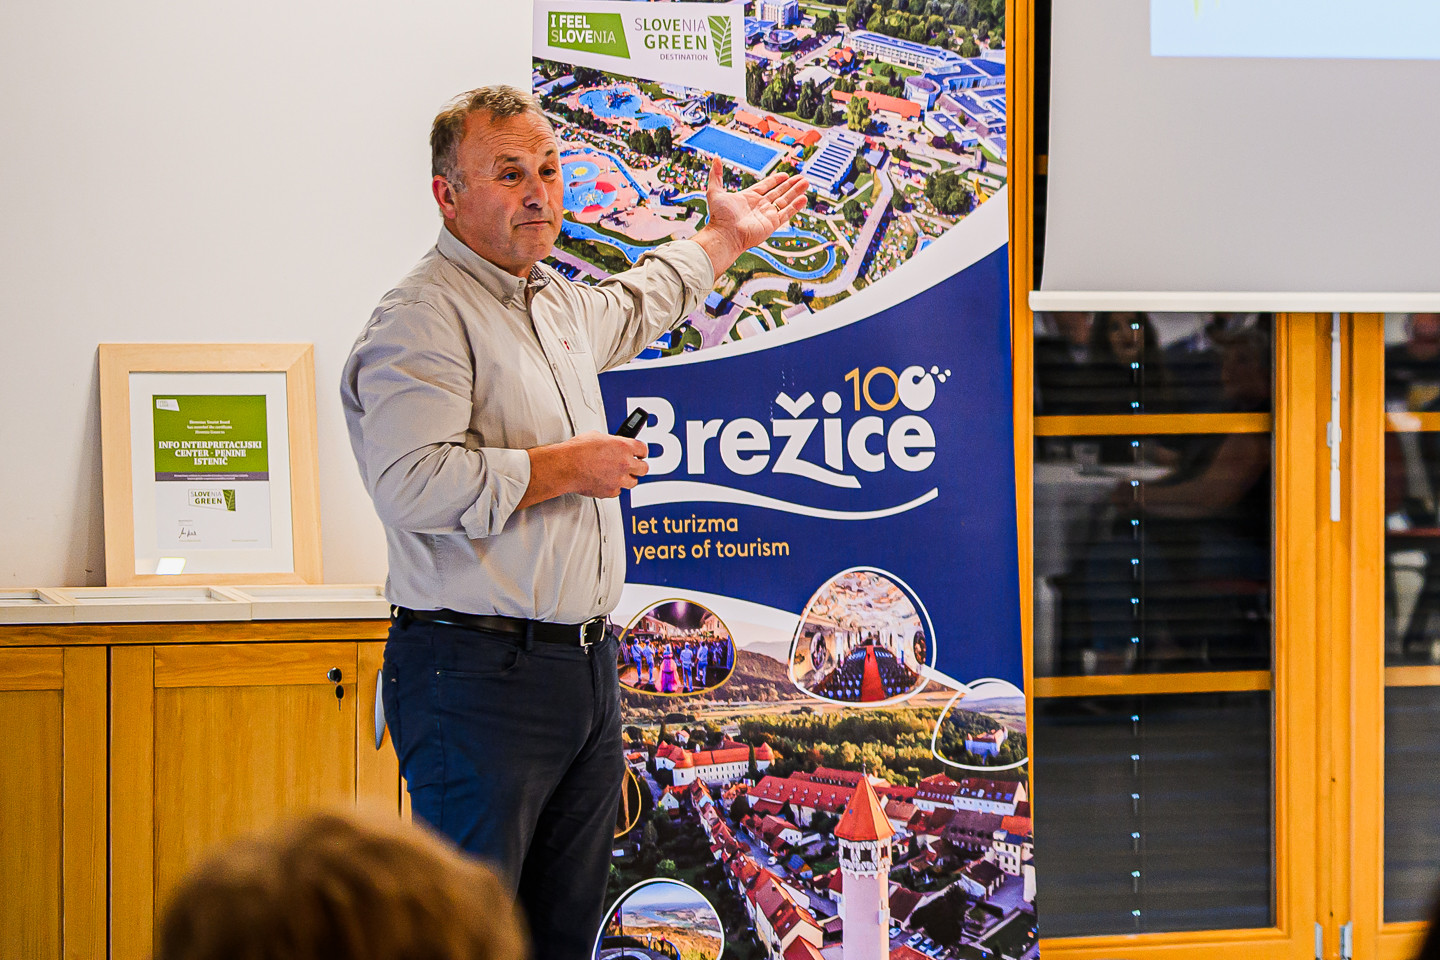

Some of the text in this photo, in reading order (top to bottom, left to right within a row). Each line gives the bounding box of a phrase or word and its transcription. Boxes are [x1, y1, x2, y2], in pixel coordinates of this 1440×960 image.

[551, 14, 591, 29] I FEEL
[634, 17, 707, 32] SLOVENIA
[551, 29, 617, 44] SLOVENIA
[643, 34, 708, 50] GREEN
[659, 53, 709, 61] DESTINATION
[158, 441, 180, 449] INFO
[626, 391, 936, 489] Brežice
[174, 449, 209, 457] CENTER
[632, 513, 739, 535] let turizma
[632, 538, 791, 565] years of tourism
